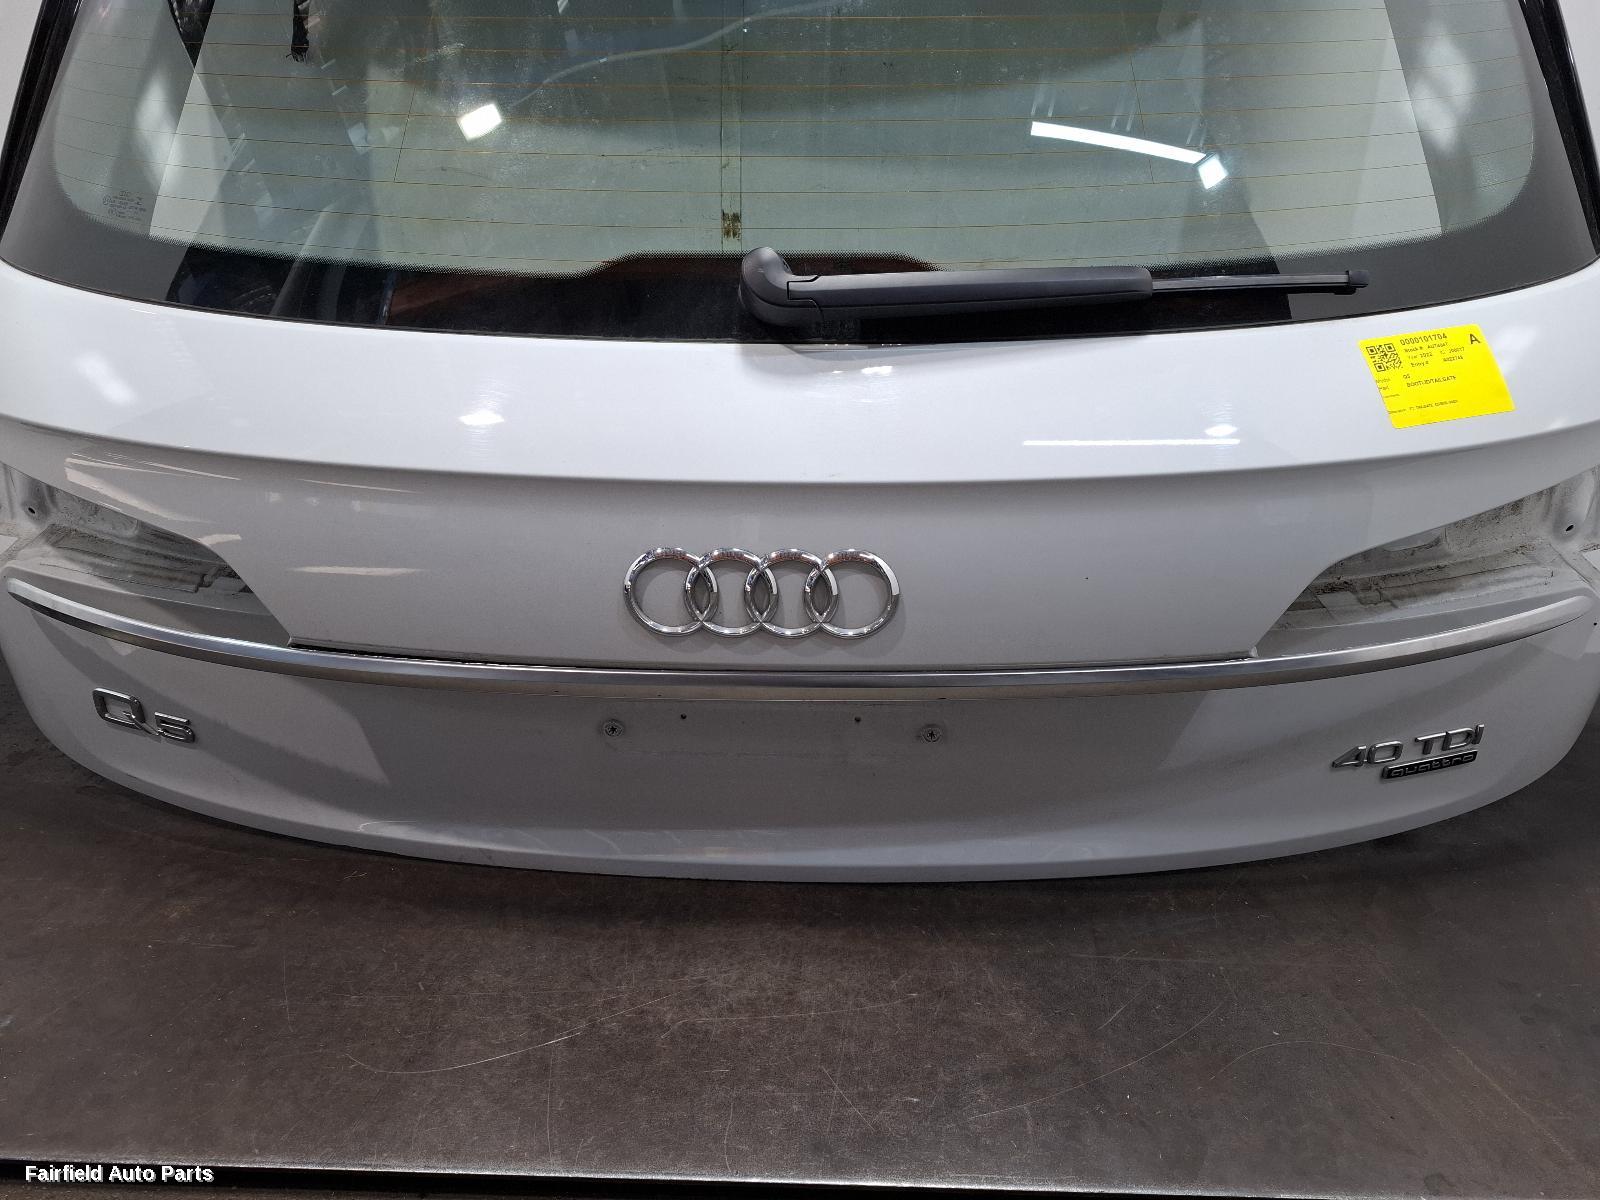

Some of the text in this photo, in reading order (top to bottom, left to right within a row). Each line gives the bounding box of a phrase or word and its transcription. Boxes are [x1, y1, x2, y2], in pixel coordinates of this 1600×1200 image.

[1399, 333, 1447, 346] 0000101704
[1469, 333, 1481, 345] A
[92, 687, 195, 743] Q5
[1331, 723, 1485, 768] 40 TDI
[1389, 753, 1475, 778] quattro
